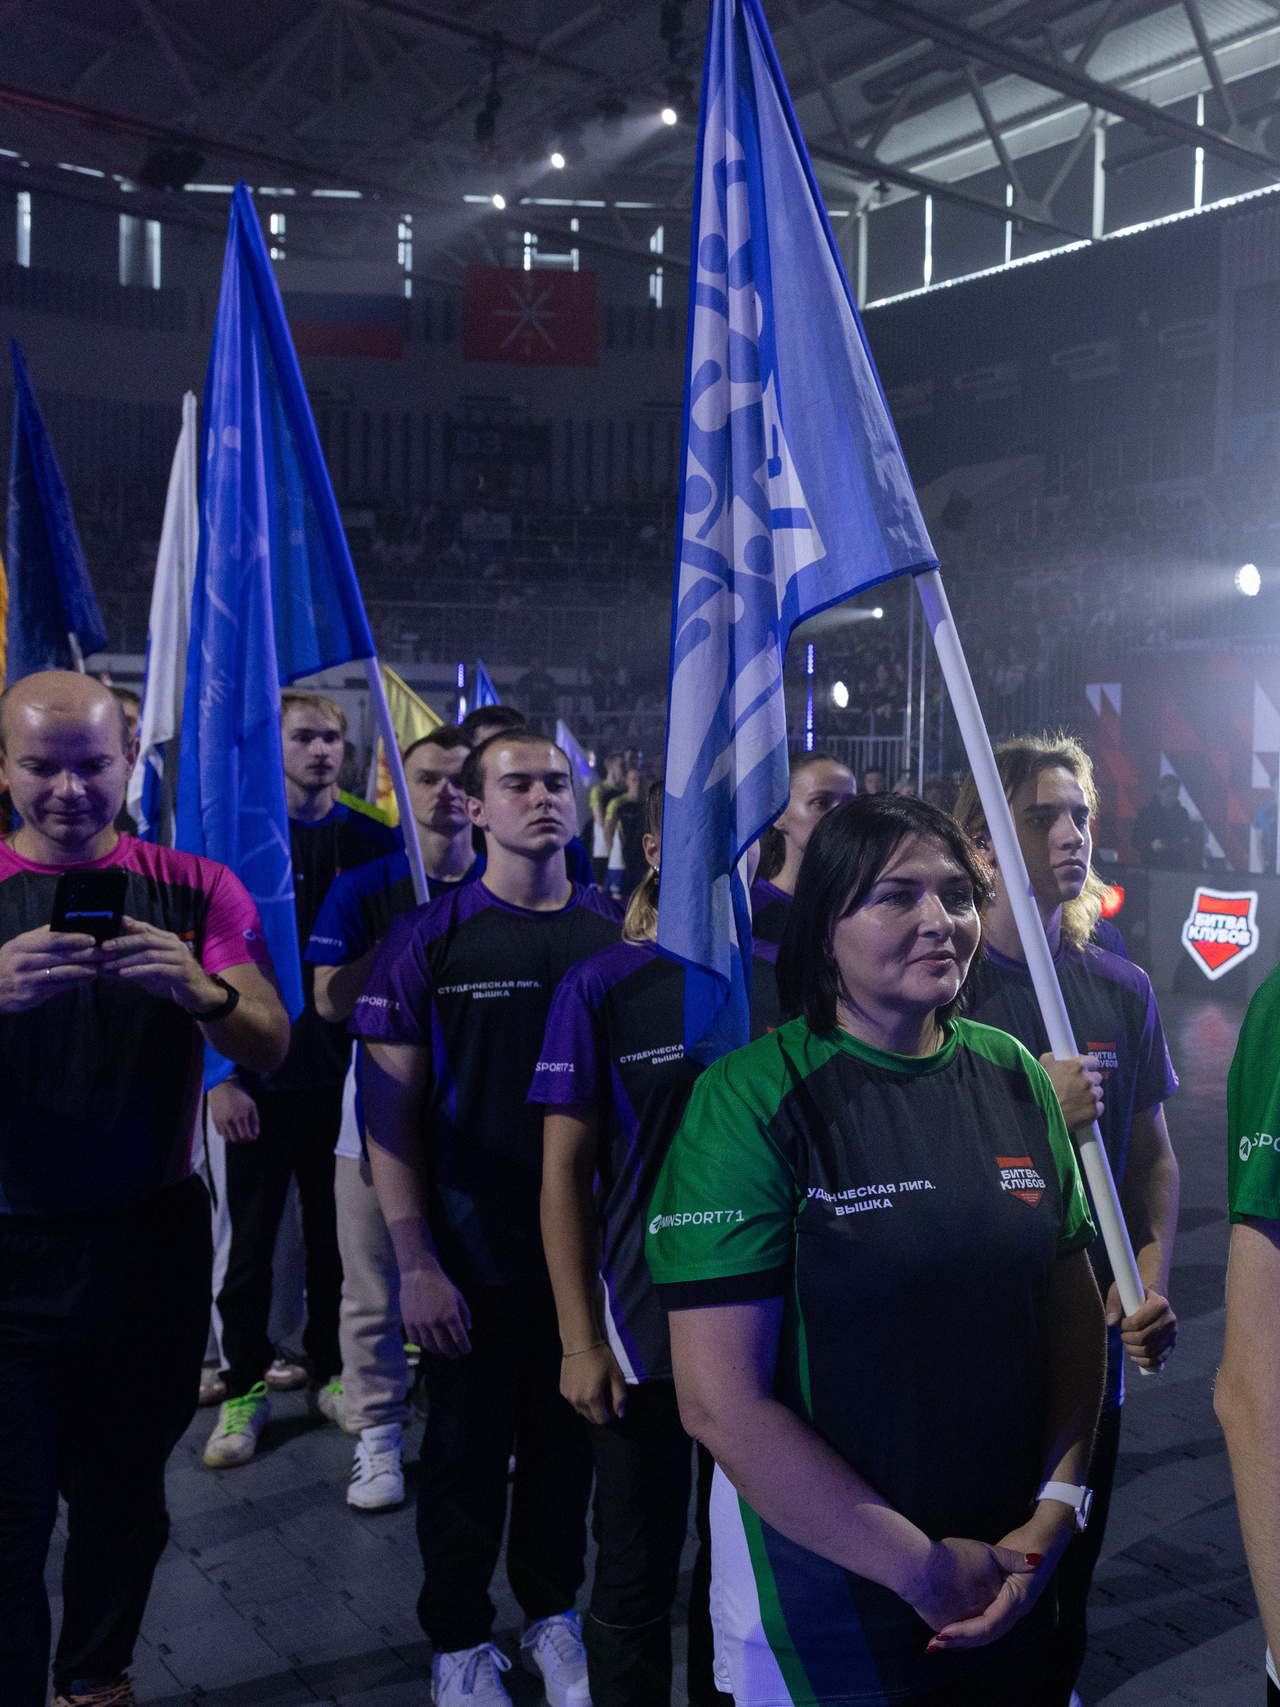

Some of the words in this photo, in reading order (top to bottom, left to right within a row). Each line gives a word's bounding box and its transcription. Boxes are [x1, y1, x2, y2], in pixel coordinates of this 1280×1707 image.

[1194, 912, 1248, 931] БИТВА
[1187, 925, 1252, 946] КЛУБОВ
[437, 980, 515, 995] СТУДЕНЧЕСКАЯ
[472, 989, 511, 999] ВЫШКА
[1000, 1168, 1040, 1180] БИТВА
[899, 1180, 936, 1192] ЛИГА.
[1000, 1179, 1046, 1190] КЛУБОВ
[834, 1198, 894, 1216] ВЫШКА
